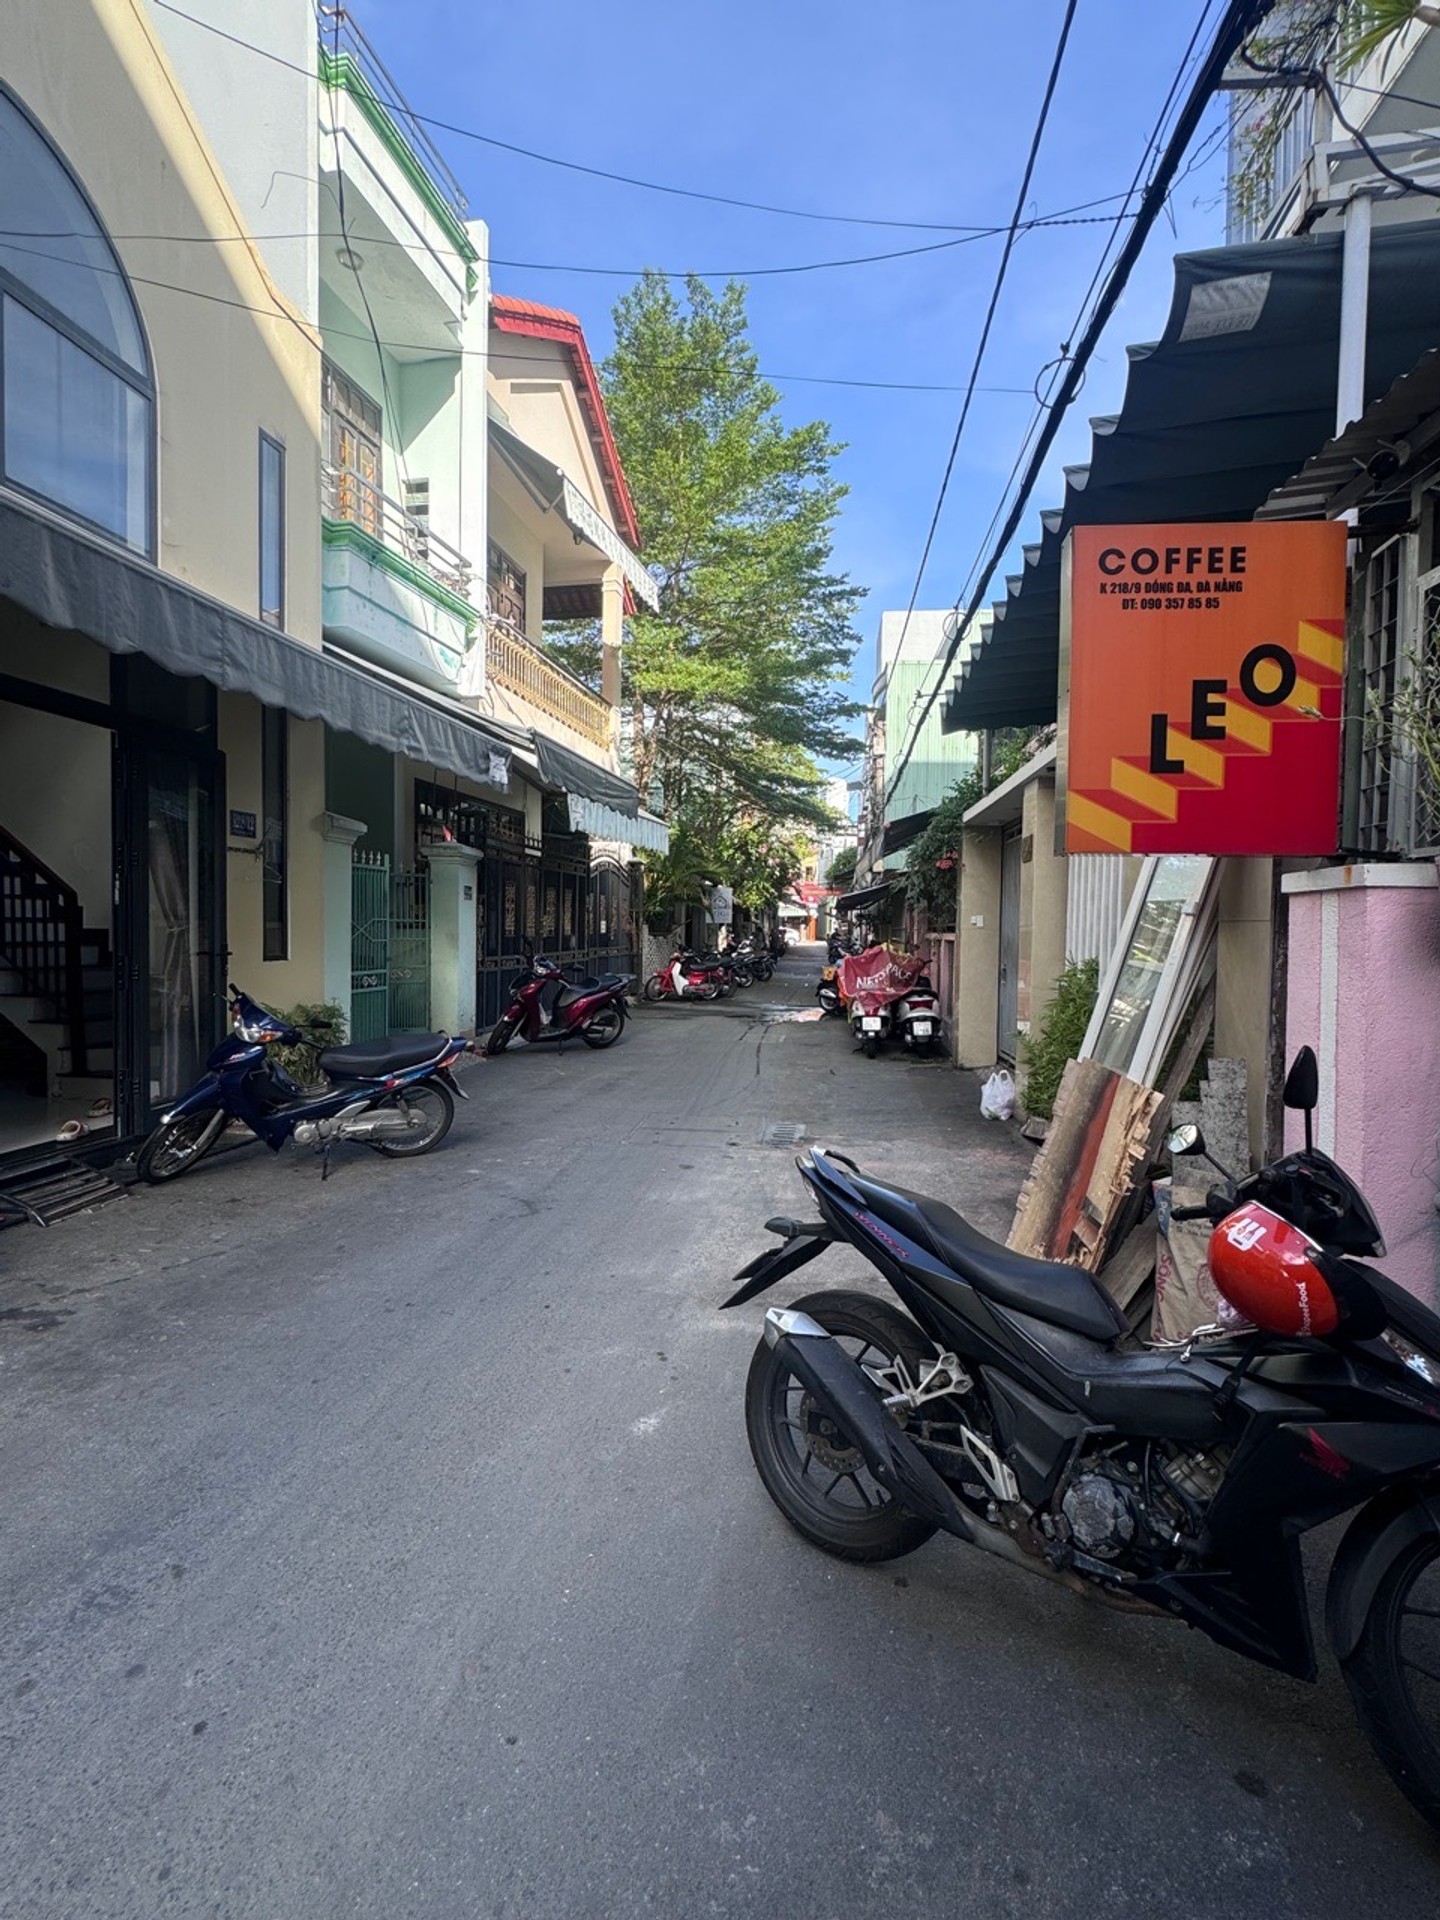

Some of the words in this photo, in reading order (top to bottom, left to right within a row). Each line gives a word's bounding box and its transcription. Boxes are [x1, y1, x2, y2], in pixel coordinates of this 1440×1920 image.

[1098, 546, 1247, 575] COFFEE
[1099, 582, 1107, 594] K
[1110, 581, 1141, 594] 218/9
[1140, 598, 1162, 610] 090
[1165, 597, 1185, 610] 357
[1188, 597, 1202, 609] 85
[1205, 597, 1220, 609] 85
[1149, 643, 1297, 774] LEO
[854, 1211, 911, 1260] WINNER
